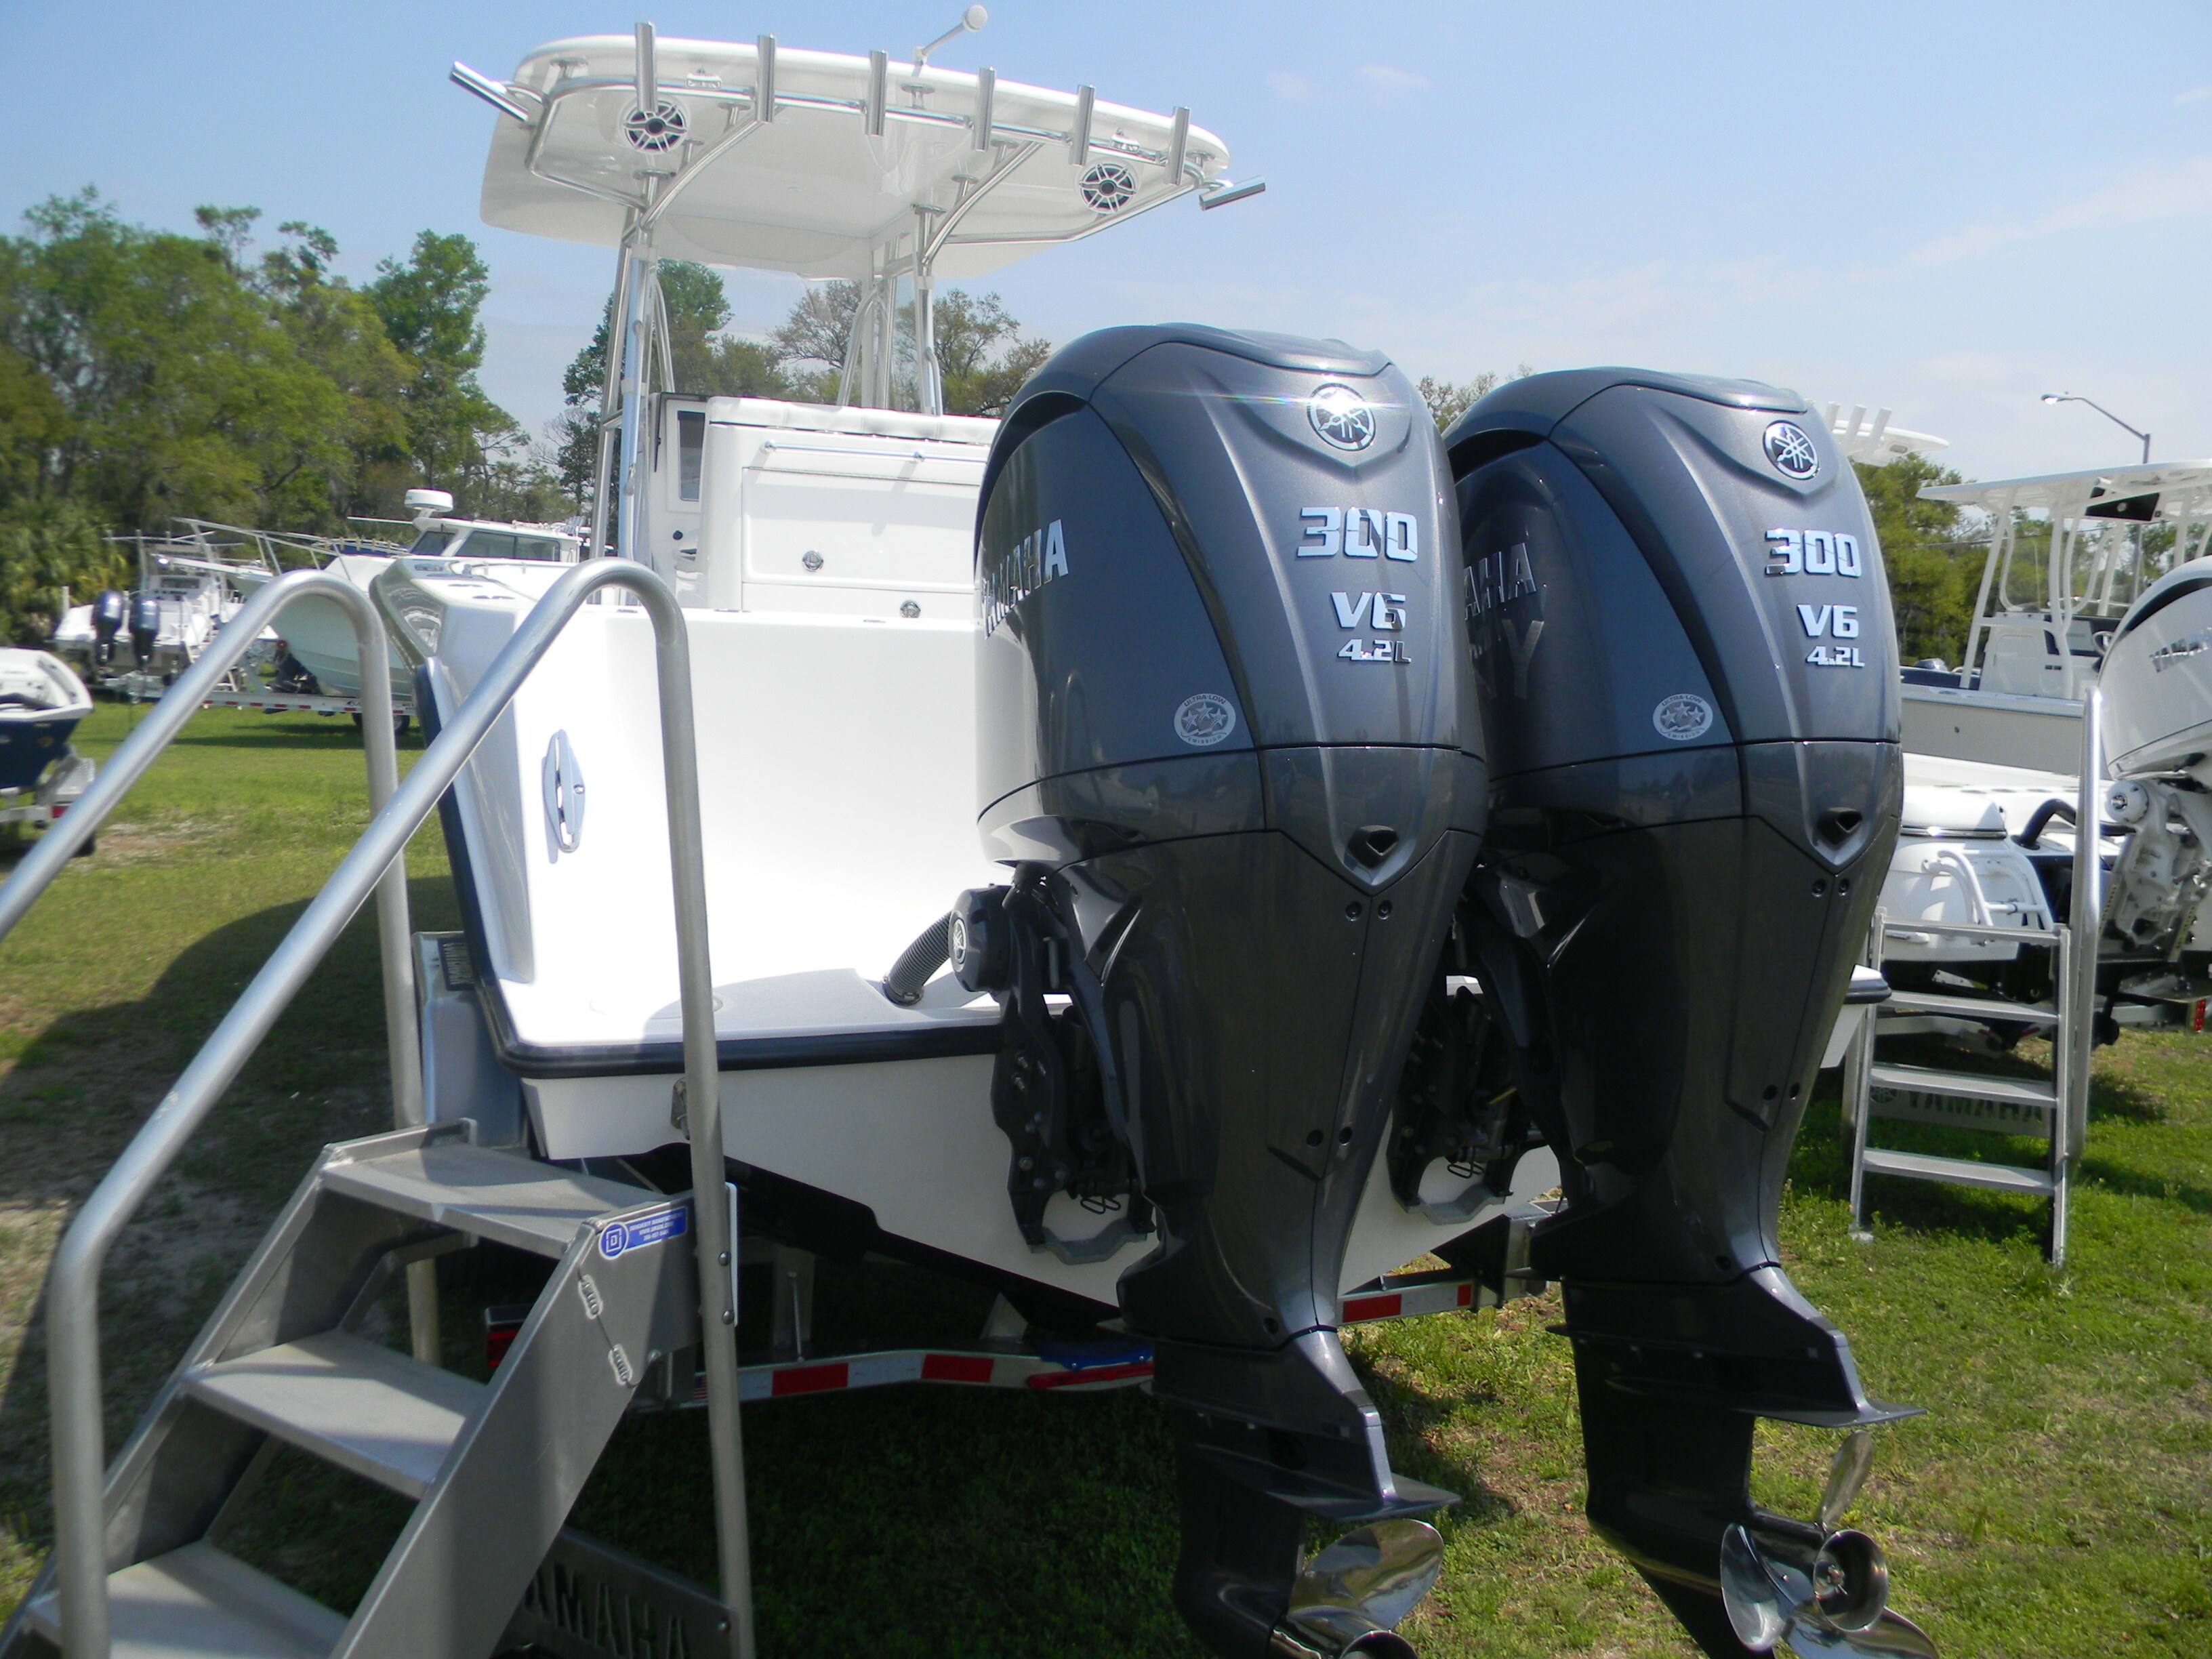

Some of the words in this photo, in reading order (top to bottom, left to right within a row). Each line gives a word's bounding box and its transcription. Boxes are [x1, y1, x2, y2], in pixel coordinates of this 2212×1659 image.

[1297, 506, 1418, 561] 300
[1765, 529, 1862, 577] 300
[1464, 543, 1537, 620] AHA
[1330, 592, 1407, 630] V6
[1797, 604, 1859, 638] V6
[1338, 638, 1412, 663] 4.2L
[1807, 645, 1865, 668] 4.2L
[525, 1561, 693, 1659] AMAHA
